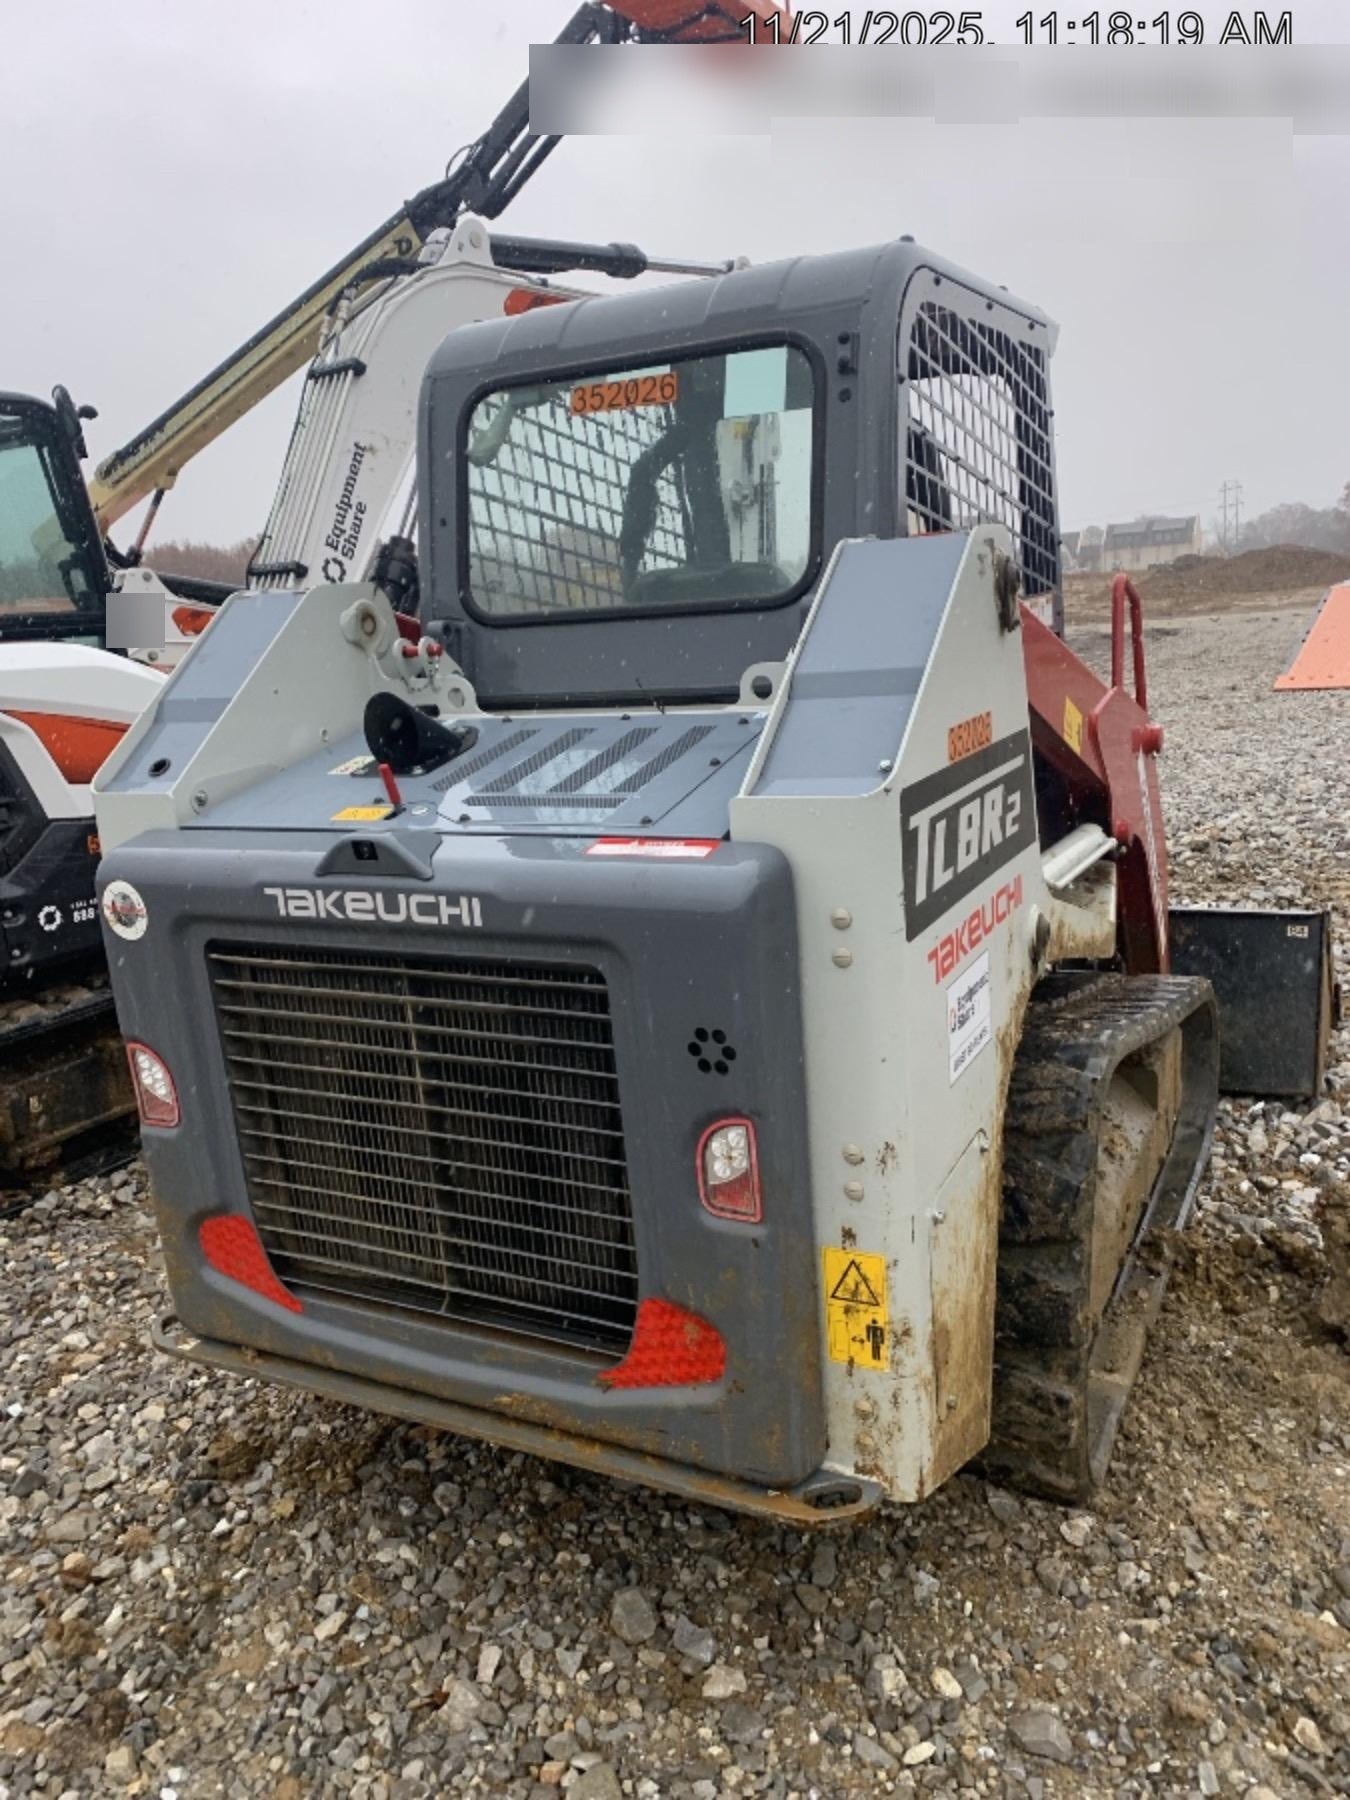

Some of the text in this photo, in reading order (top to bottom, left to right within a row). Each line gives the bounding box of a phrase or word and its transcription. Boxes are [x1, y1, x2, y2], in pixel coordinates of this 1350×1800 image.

[572, 373, 675, 413] 352026
[325, 440, 367, 552] Equipment
[342, 501, 367, 561] Share
